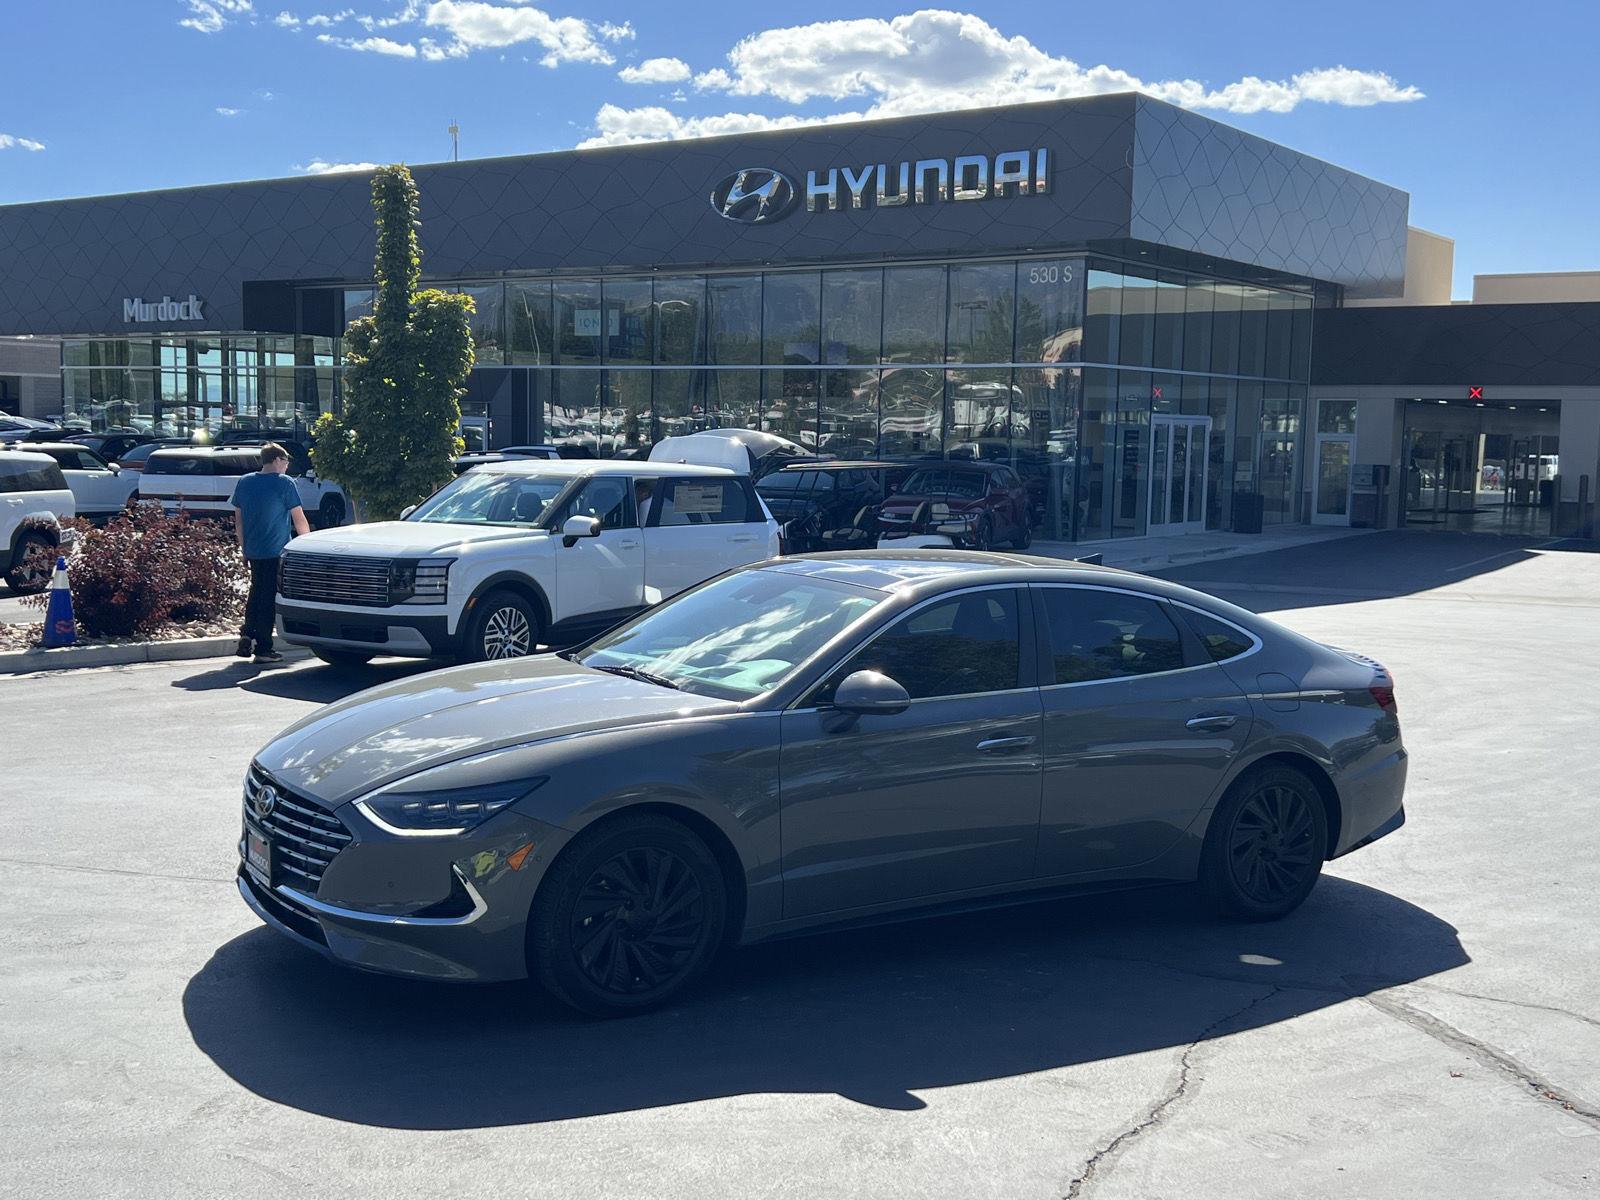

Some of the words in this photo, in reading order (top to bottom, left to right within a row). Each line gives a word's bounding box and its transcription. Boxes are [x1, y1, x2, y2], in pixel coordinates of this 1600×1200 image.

[806, 147, 1049, 212] HYUNDAI
[1029, 266, 1059, 284] 530
[1063, 265, 1073, 283] S
[123, 294, 204, 323] Murdock
